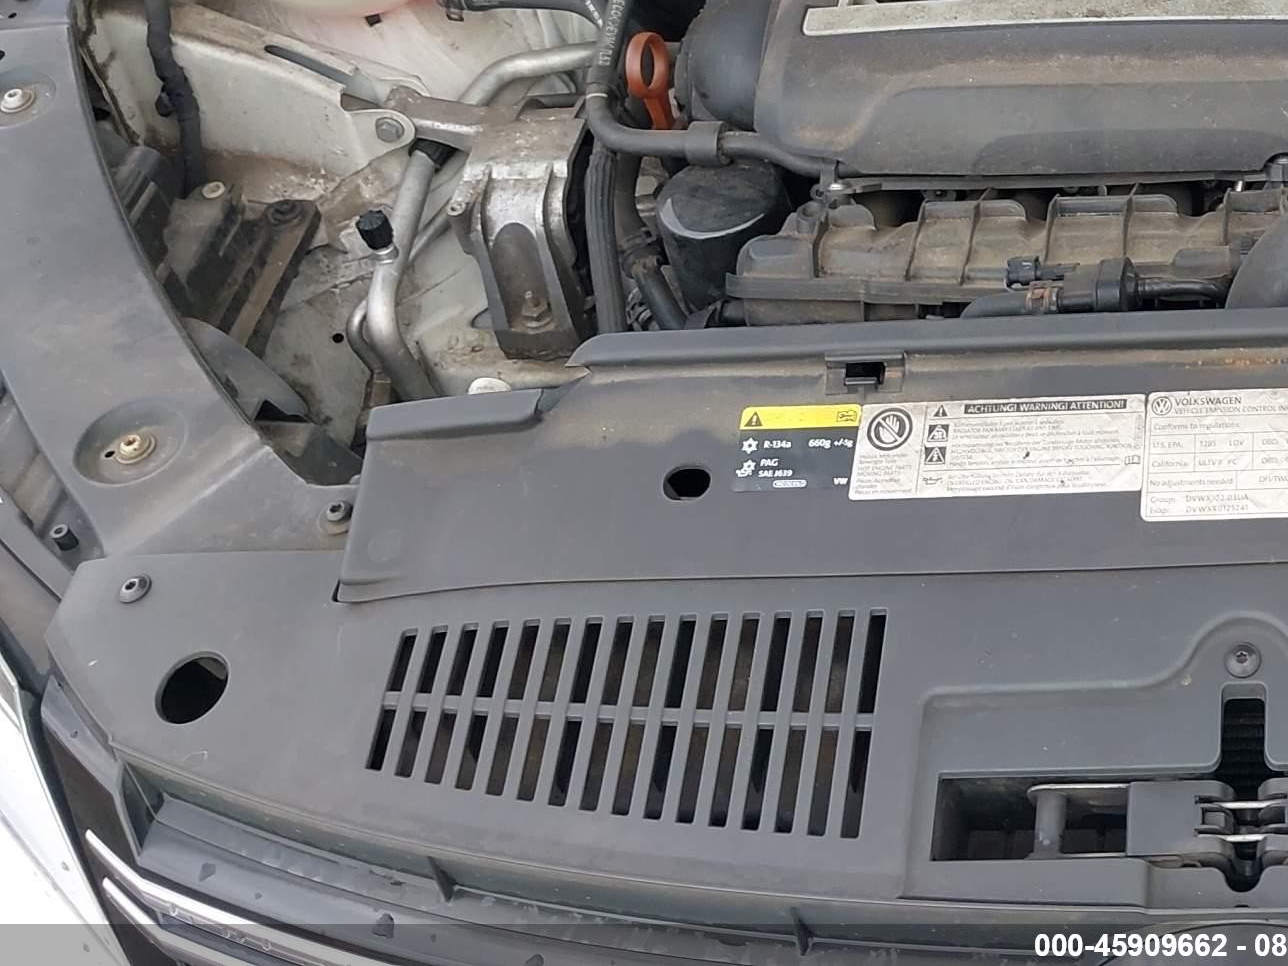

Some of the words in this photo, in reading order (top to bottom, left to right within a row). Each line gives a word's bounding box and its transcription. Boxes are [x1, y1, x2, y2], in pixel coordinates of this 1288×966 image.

[1175, 396, 1242, 406] VOLKSWAGEN
[967, 403, 1017, 413] ACHTUNG!
[1020, 402, 1068, 412] WARNING!
[1070, 400, 1124, 410] ATTENTION!
[1242, 405, 1276, 413] CONTROL
[1153, 422, 1188, 430] Conforms
[764, 440, 791, 449] R-134a
[808, 439, 831, 448] 660g
[760, 459, 779, 467] PAG
